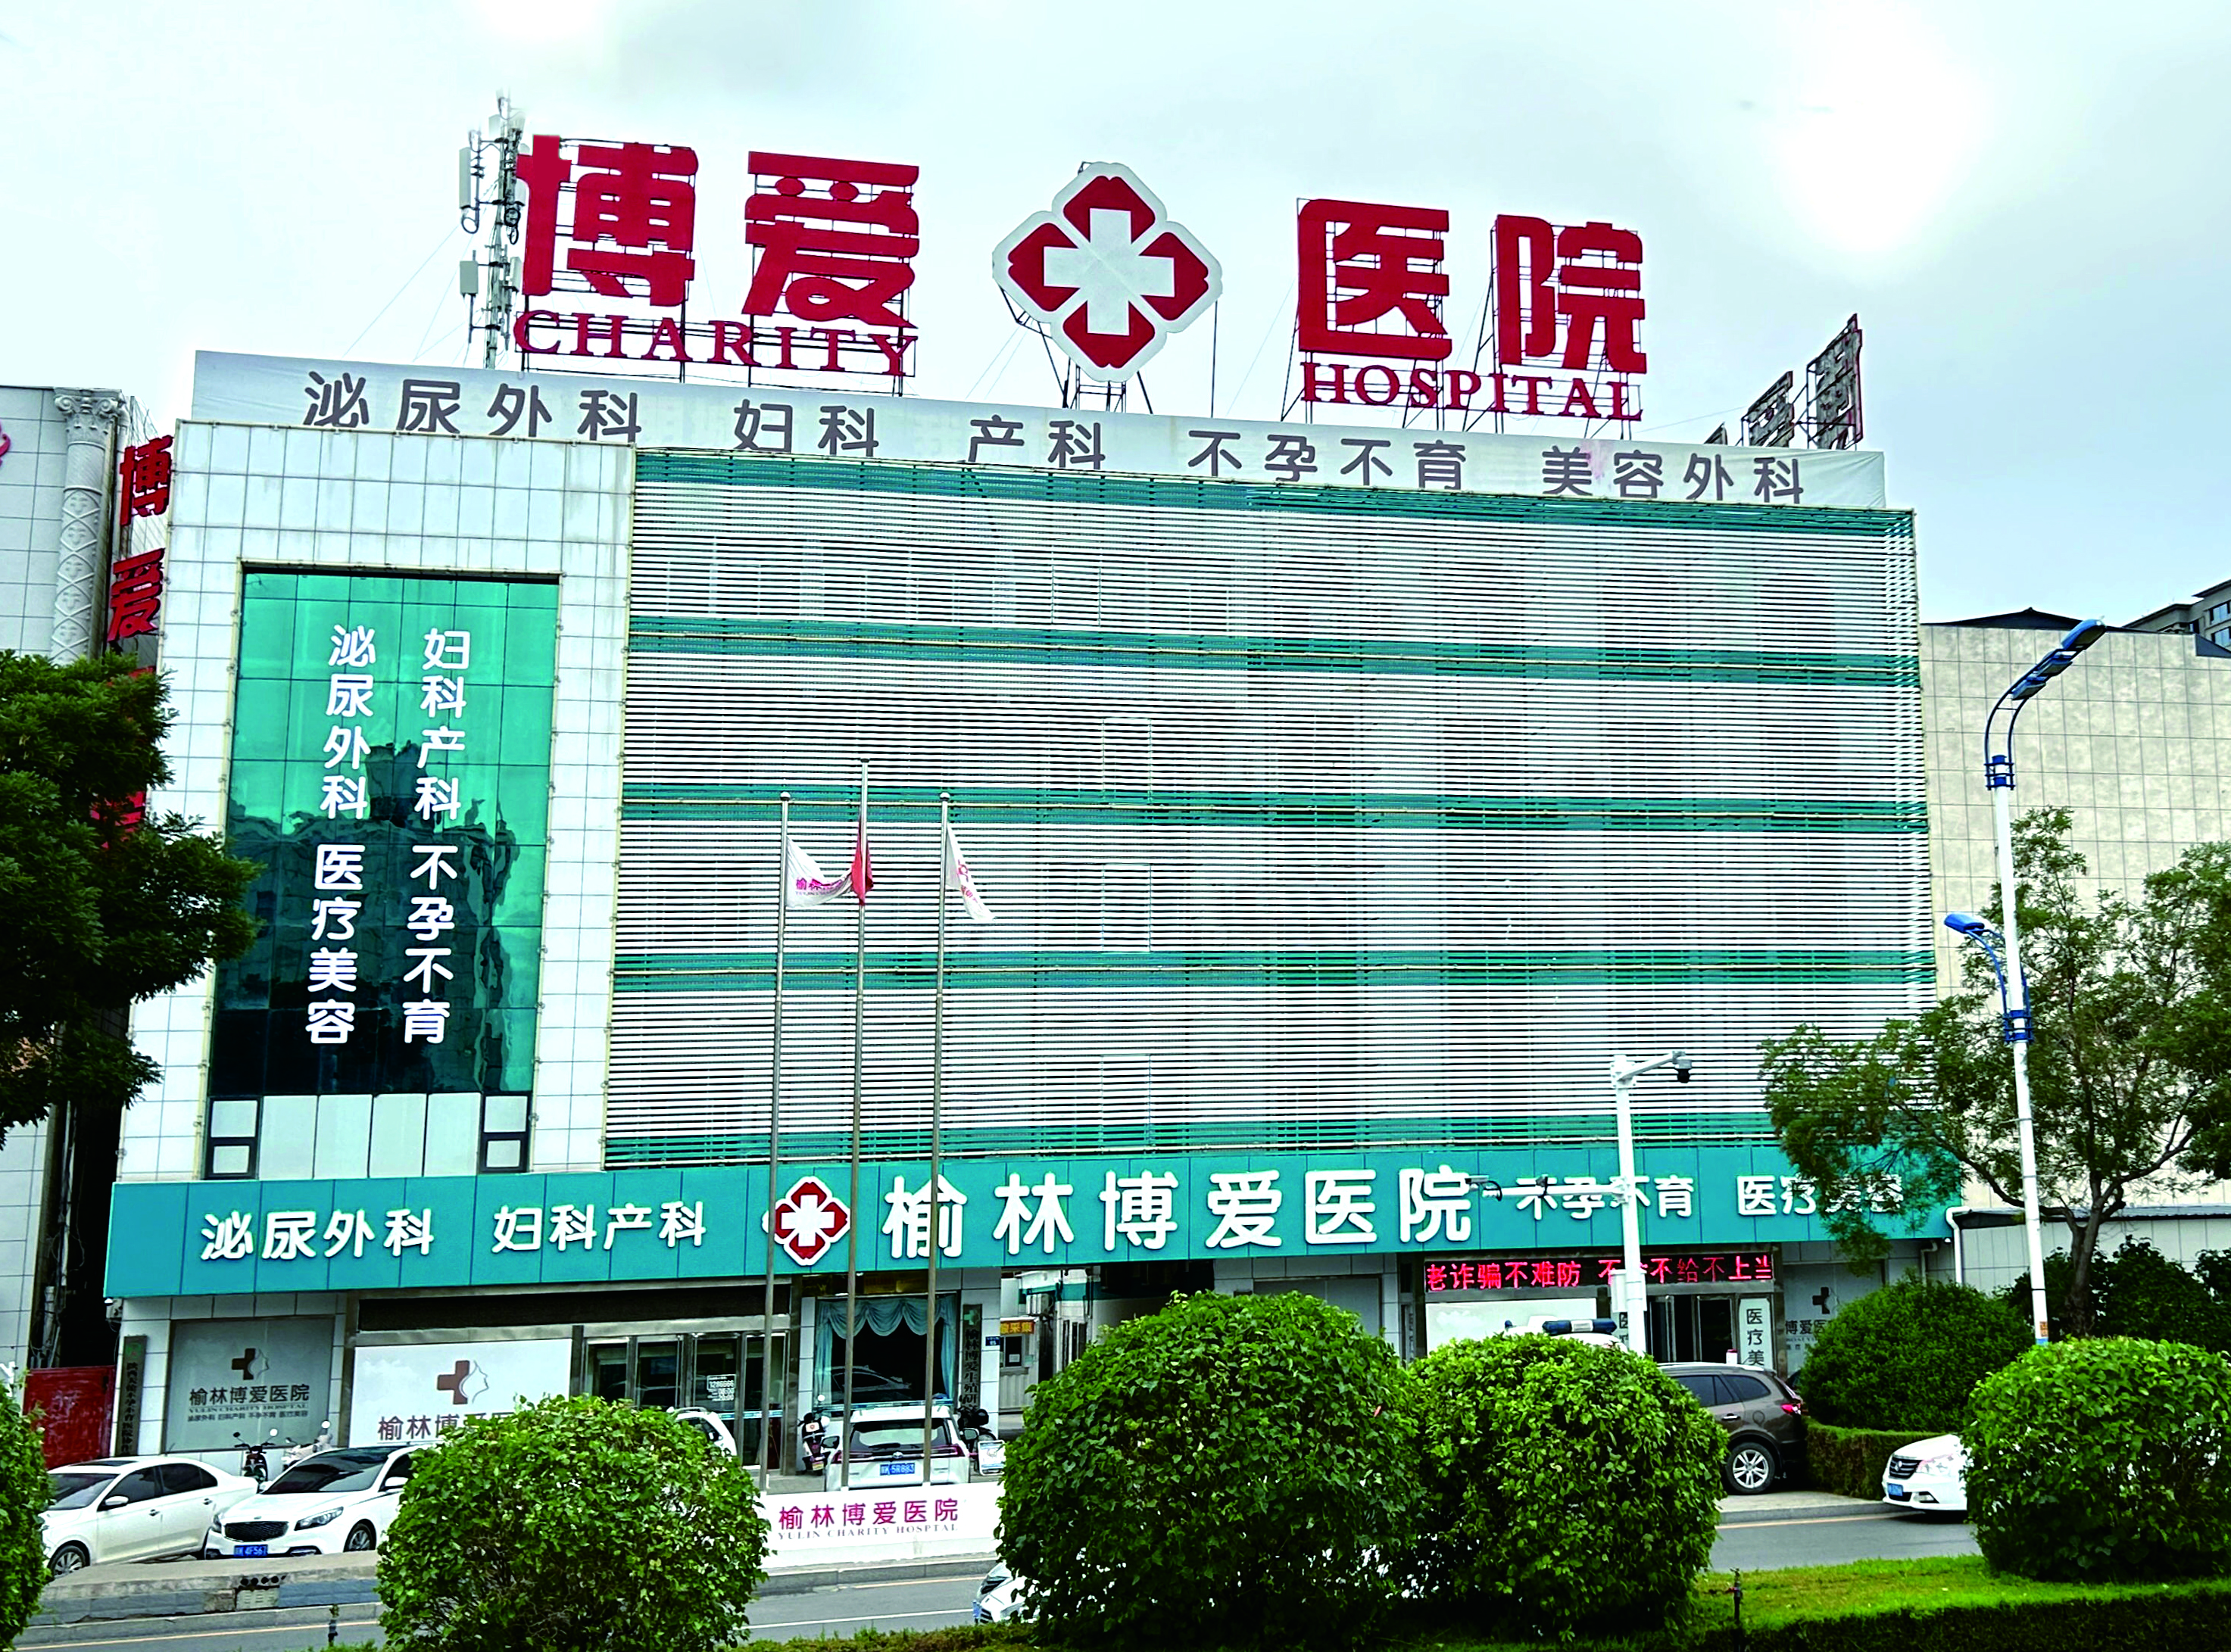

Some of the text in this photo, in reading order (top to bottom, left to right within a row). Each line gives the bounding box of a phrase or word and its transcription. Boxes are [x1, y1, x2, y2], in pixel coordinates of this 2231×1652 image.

[516, 135, 1648, 374] 博爱 医院
[513, 309, 919, 377] CHARITY
[1300, 361, 1644, 422] HOSPITAL
[304, 369, 1804, 504] 泌尿外科 妇科 产科 不孕不育 美容外科
[305, 624, 376, 1045] 泌尿外科 医疗美容
[402, 627, 470, 1045] 妇科产科 不孕不育
[199, 1208, 435, 1261] 泌尿外科
[491, 1200, 708, 1255] 妇科产科
[881, 1165, 1472, 1258] 榆林博爱医院
[1598, 1255, 1772, 1286] 不不给不上当
[189, 1384, 310, 1406] 榆林博爱医院
[778, 1530, 821, 1540] YULIN
[828, 1527, 889, 1538] CHARITY
[779, 1498, 959, 1530] 榆林博爱医院
